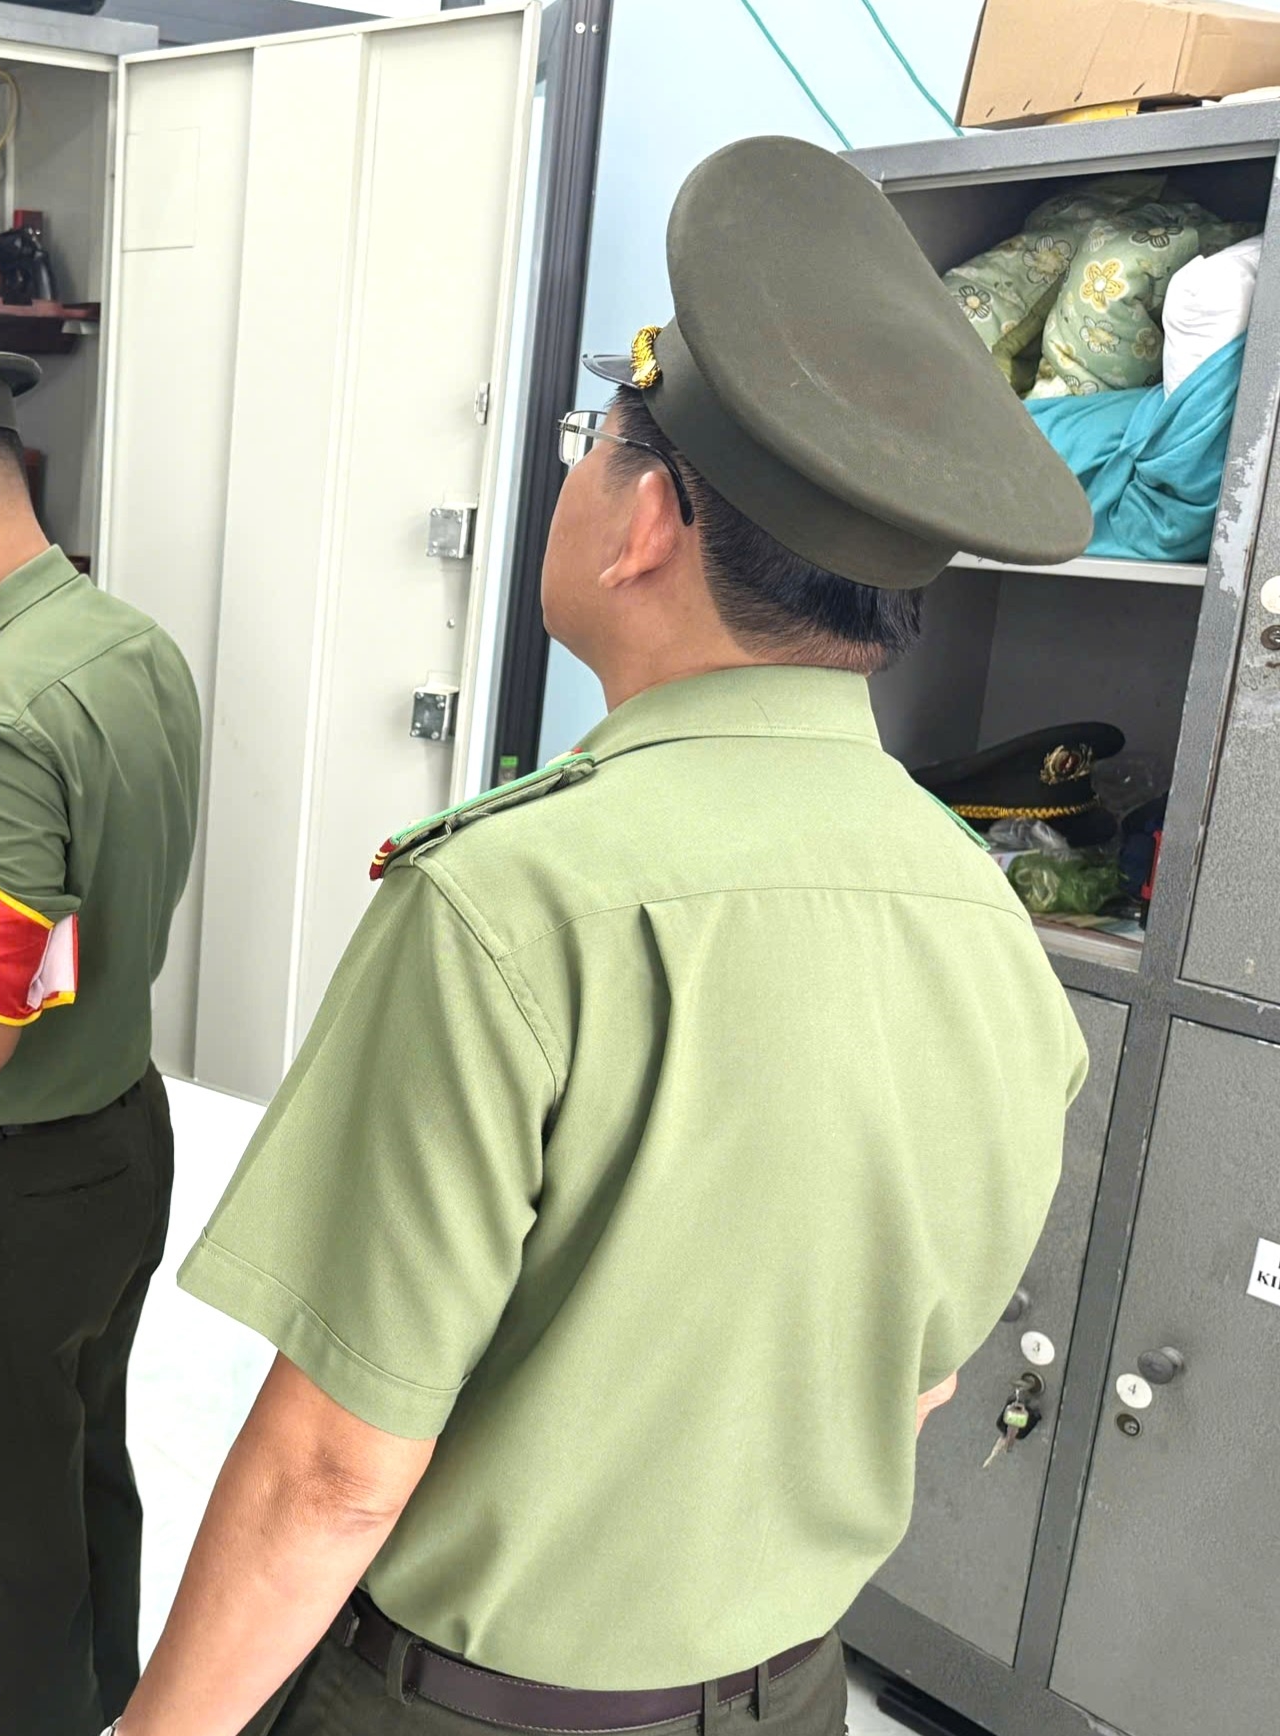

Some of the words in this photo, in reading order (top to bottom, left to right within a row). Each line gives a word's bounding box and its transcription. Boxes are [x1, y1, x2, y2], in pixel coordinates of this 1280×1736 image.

[1257, 1270, 1280, 1290] KI
[1032, 1340, 1041, 1352] 3
[1127, 1383, 1137, 1395] 4
